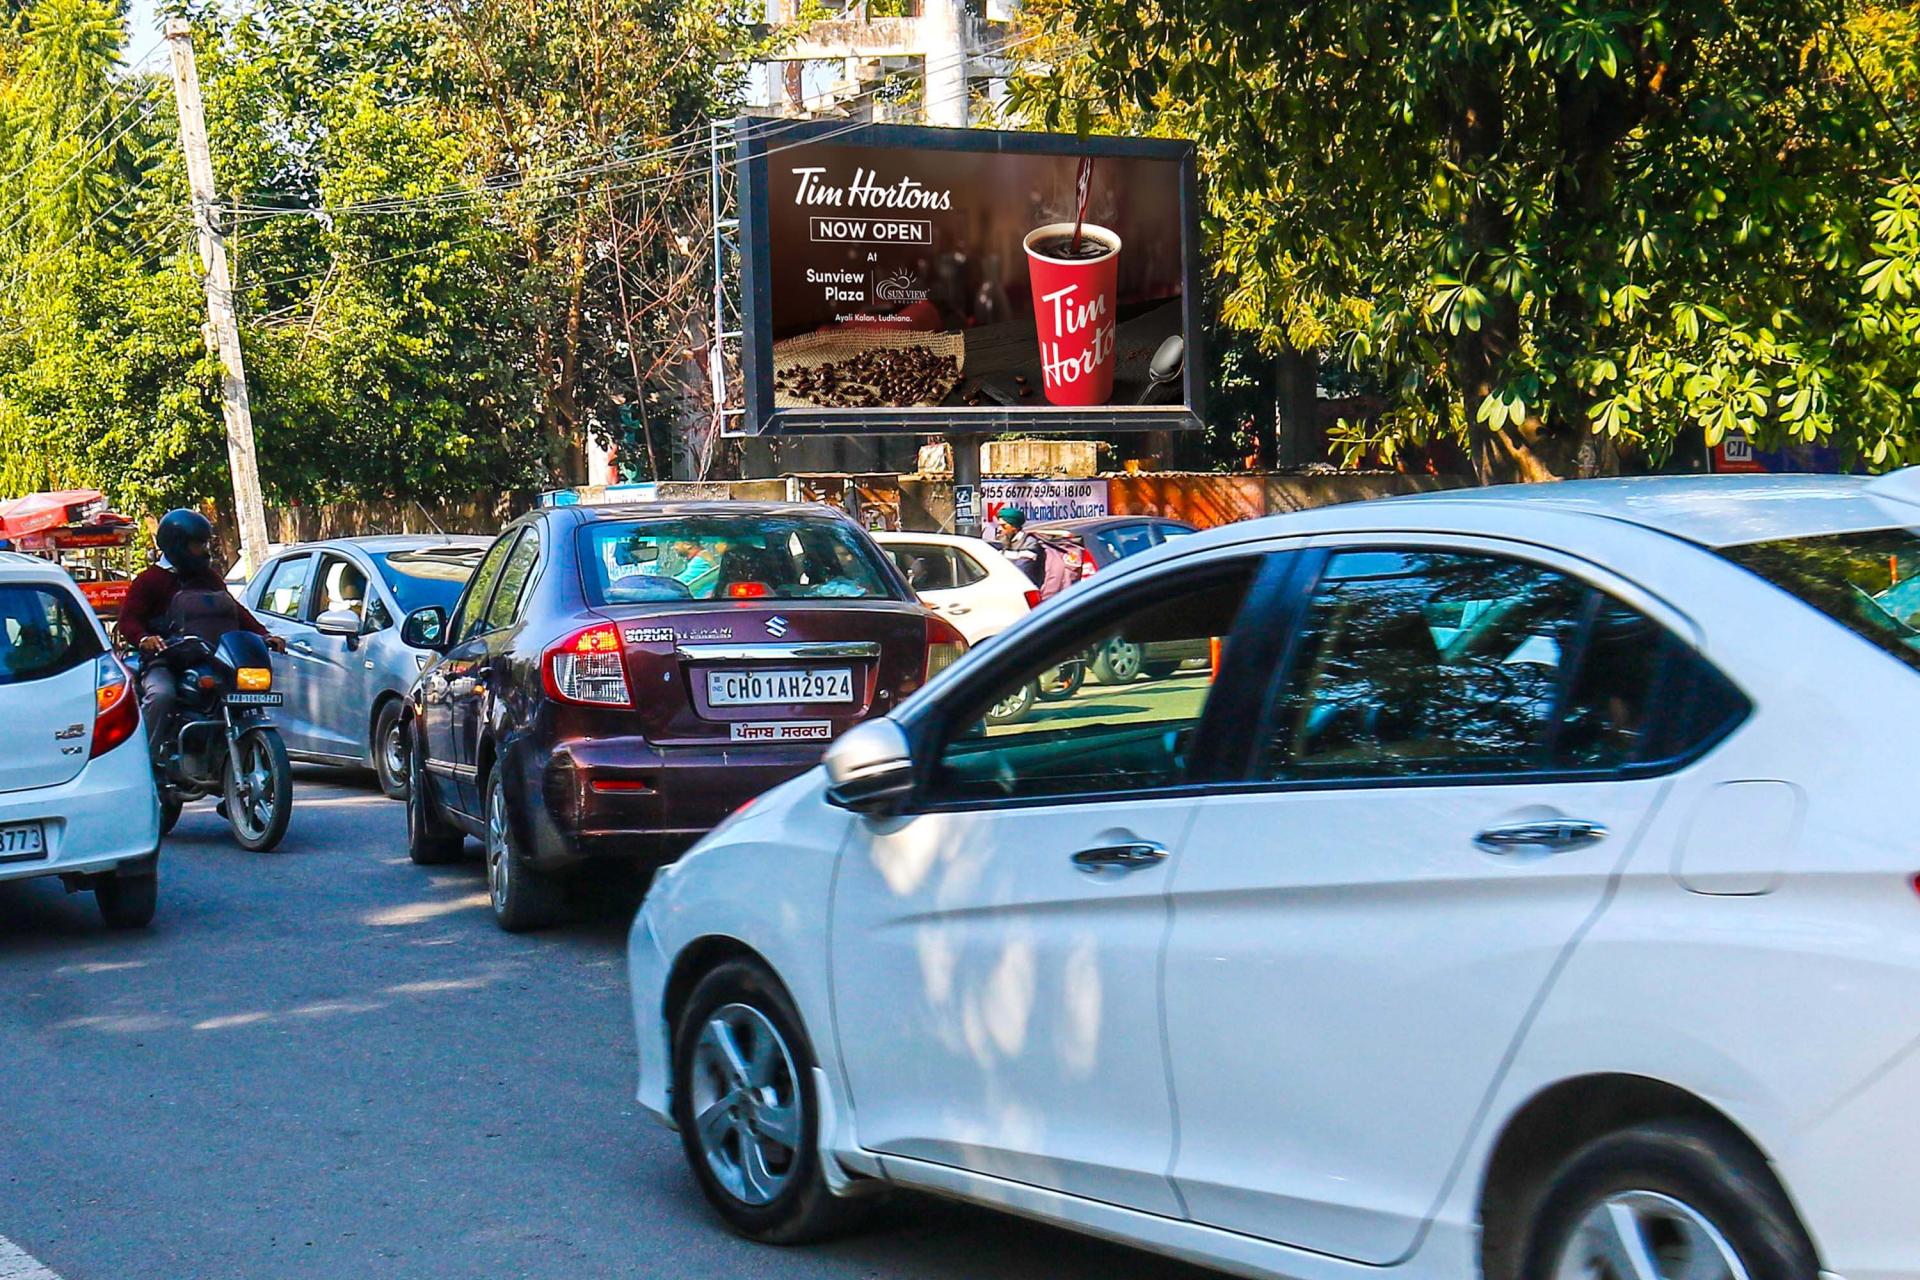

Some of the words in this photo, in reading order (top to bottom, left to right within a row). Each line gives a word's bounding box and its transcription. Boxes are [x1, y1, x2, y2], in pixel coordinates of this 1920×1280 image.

[792, 167, 843, 207] Tim
[848, 167, 951, 210] Hortons
[820, 221, 867, 239] NOW
[873, 223, 922, 241] OPEN
[867, 252, 877, 261] At
[806, 268, 864, 284] Sunview
[825, 286, 864, 301] Plaza
[887, 289, 904, 299] SUN
[905, 290, 927, 299] VIEW
[1042, 284, 1105, 338] Tim
[1070, 499, 1105, 519] Square
[625, 634, 673, 642] SUZUKI
[727, 676, 849, 699] CH01AH2924
[737, 723, 775, 738] ਪੰਜਾਬ
[781, 725, 828, 738] ਸਰਕਾਰ
